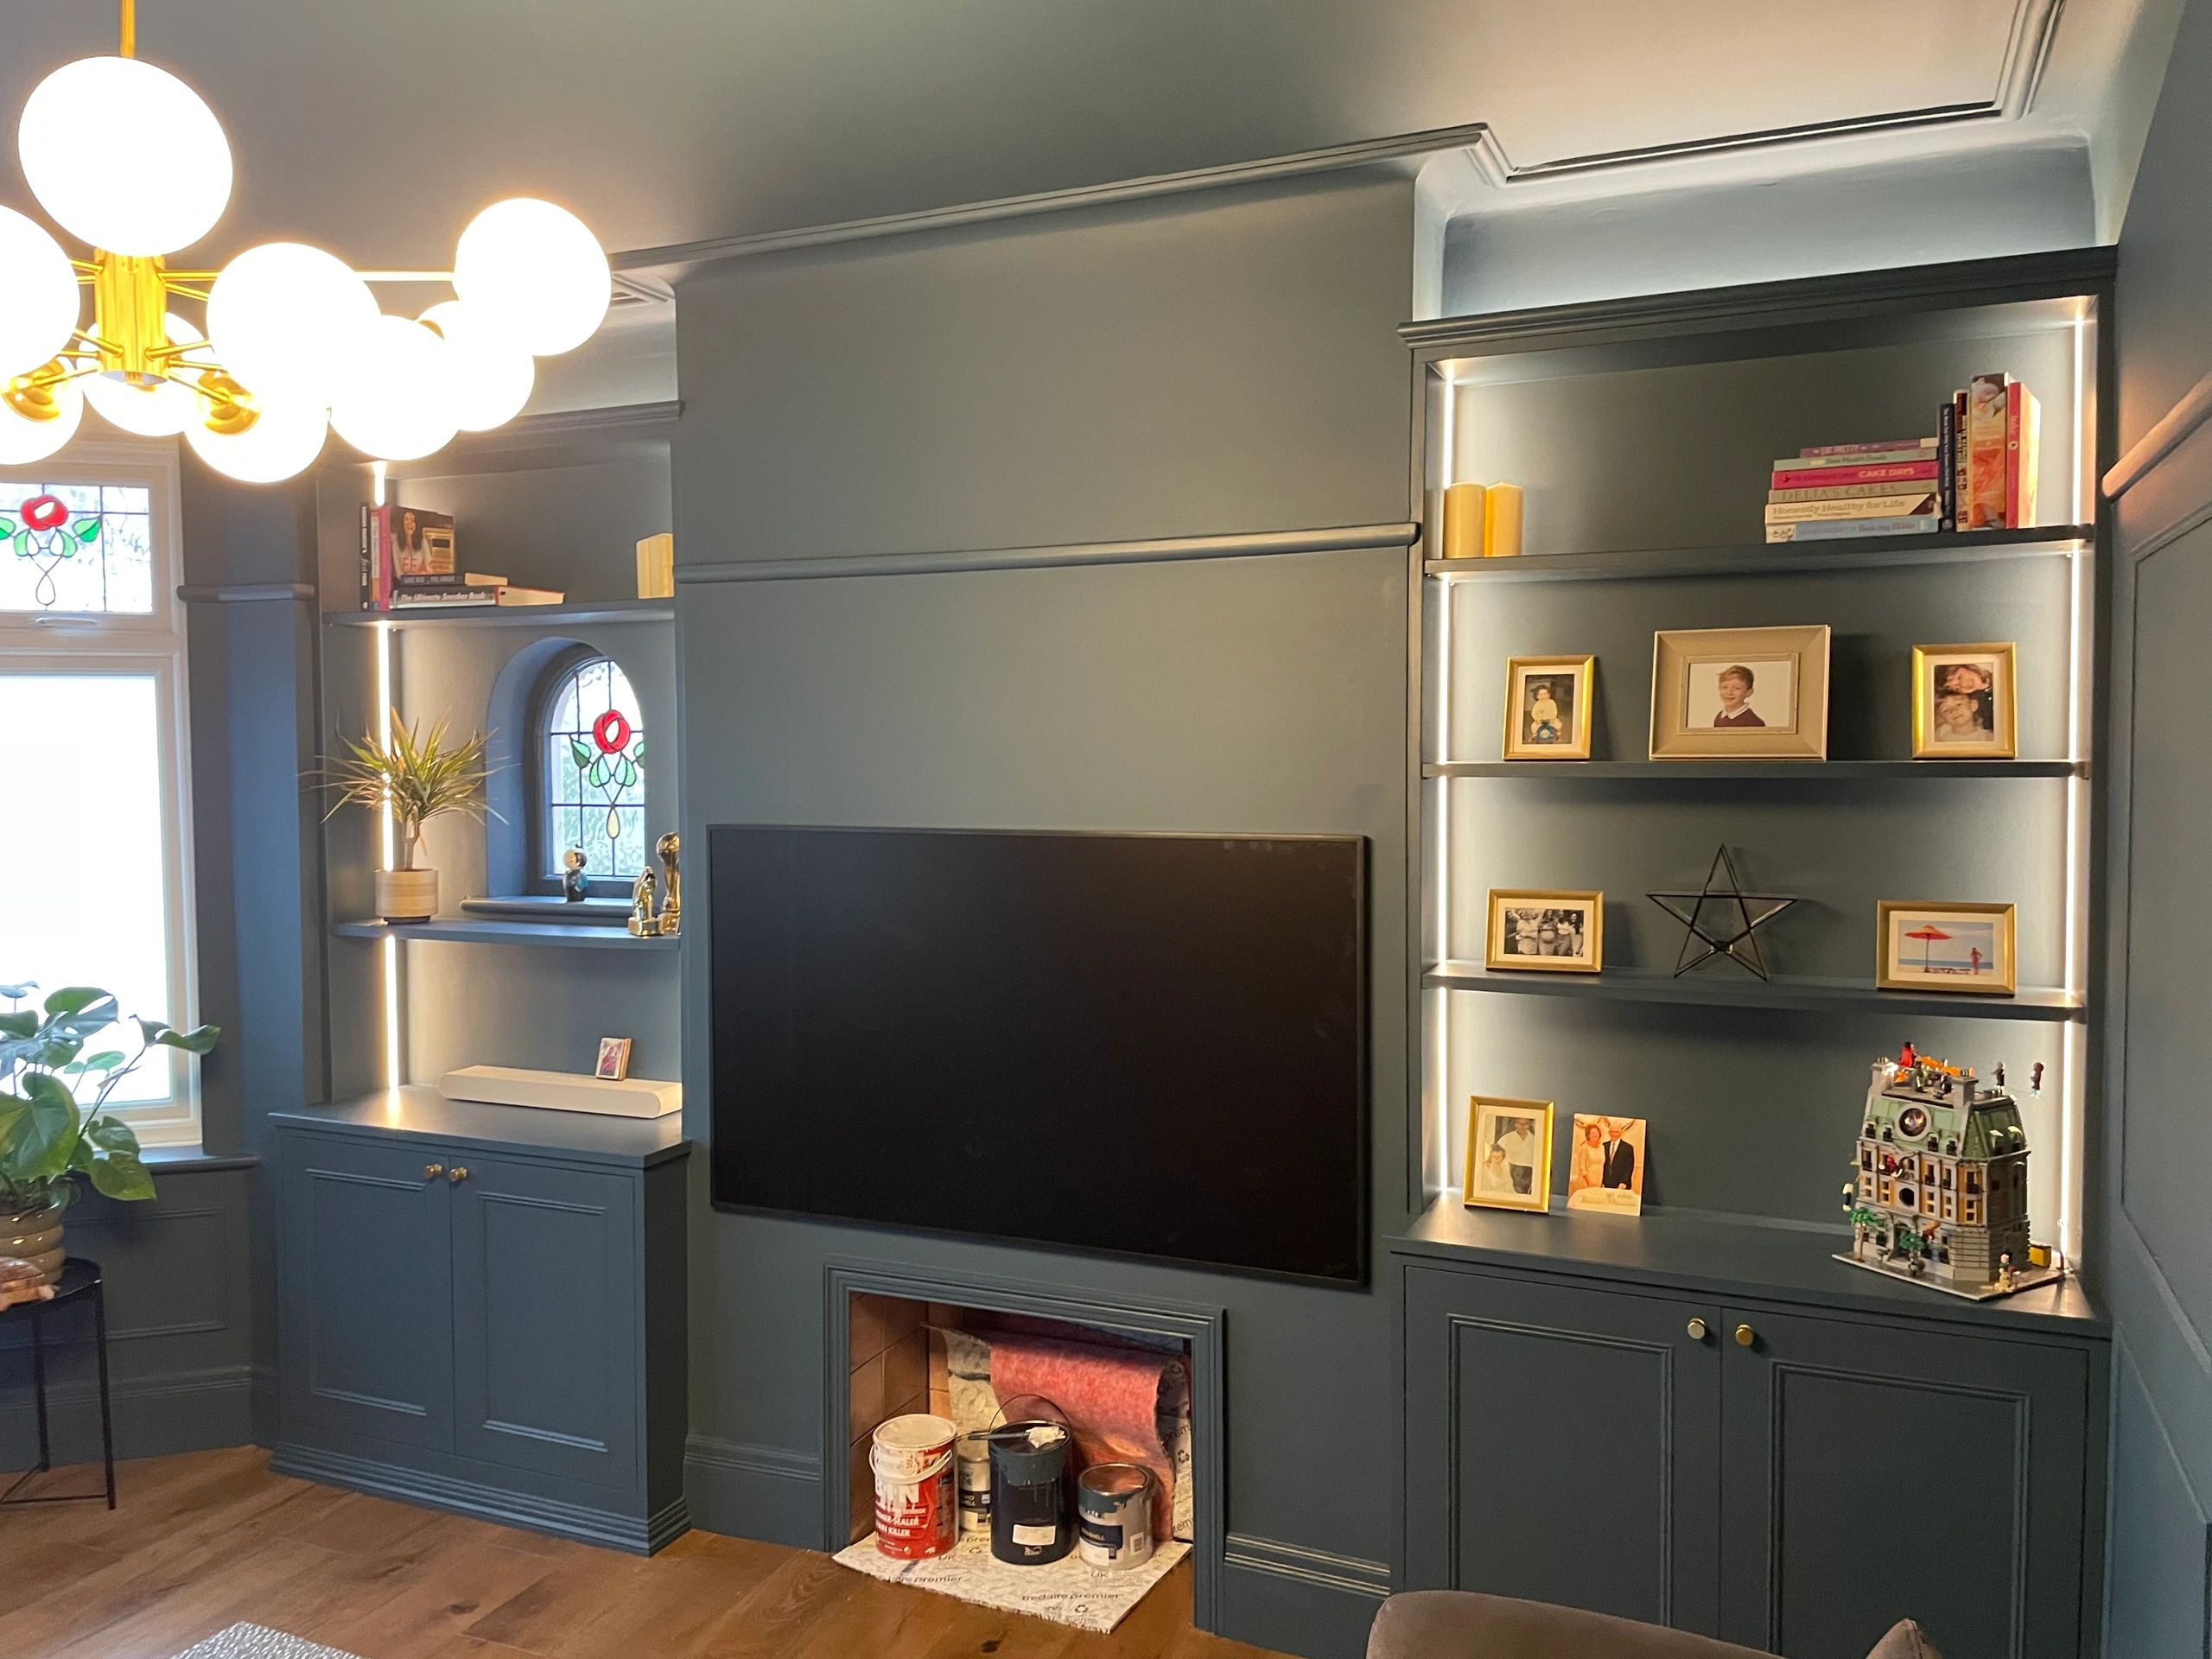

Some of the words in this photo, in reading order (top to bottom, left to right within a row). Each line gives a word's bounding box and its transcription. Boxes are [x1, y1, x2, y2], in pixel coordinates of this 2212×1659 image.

[1859, 470, 1886, 479] CAKE
[1888, 467, 1915, 476] DAYS
[1845, 484, 1897, 497] CAKES
[1884, 499, 1905, 507] Life
[887, 1526, 911, 1537] KILLER
